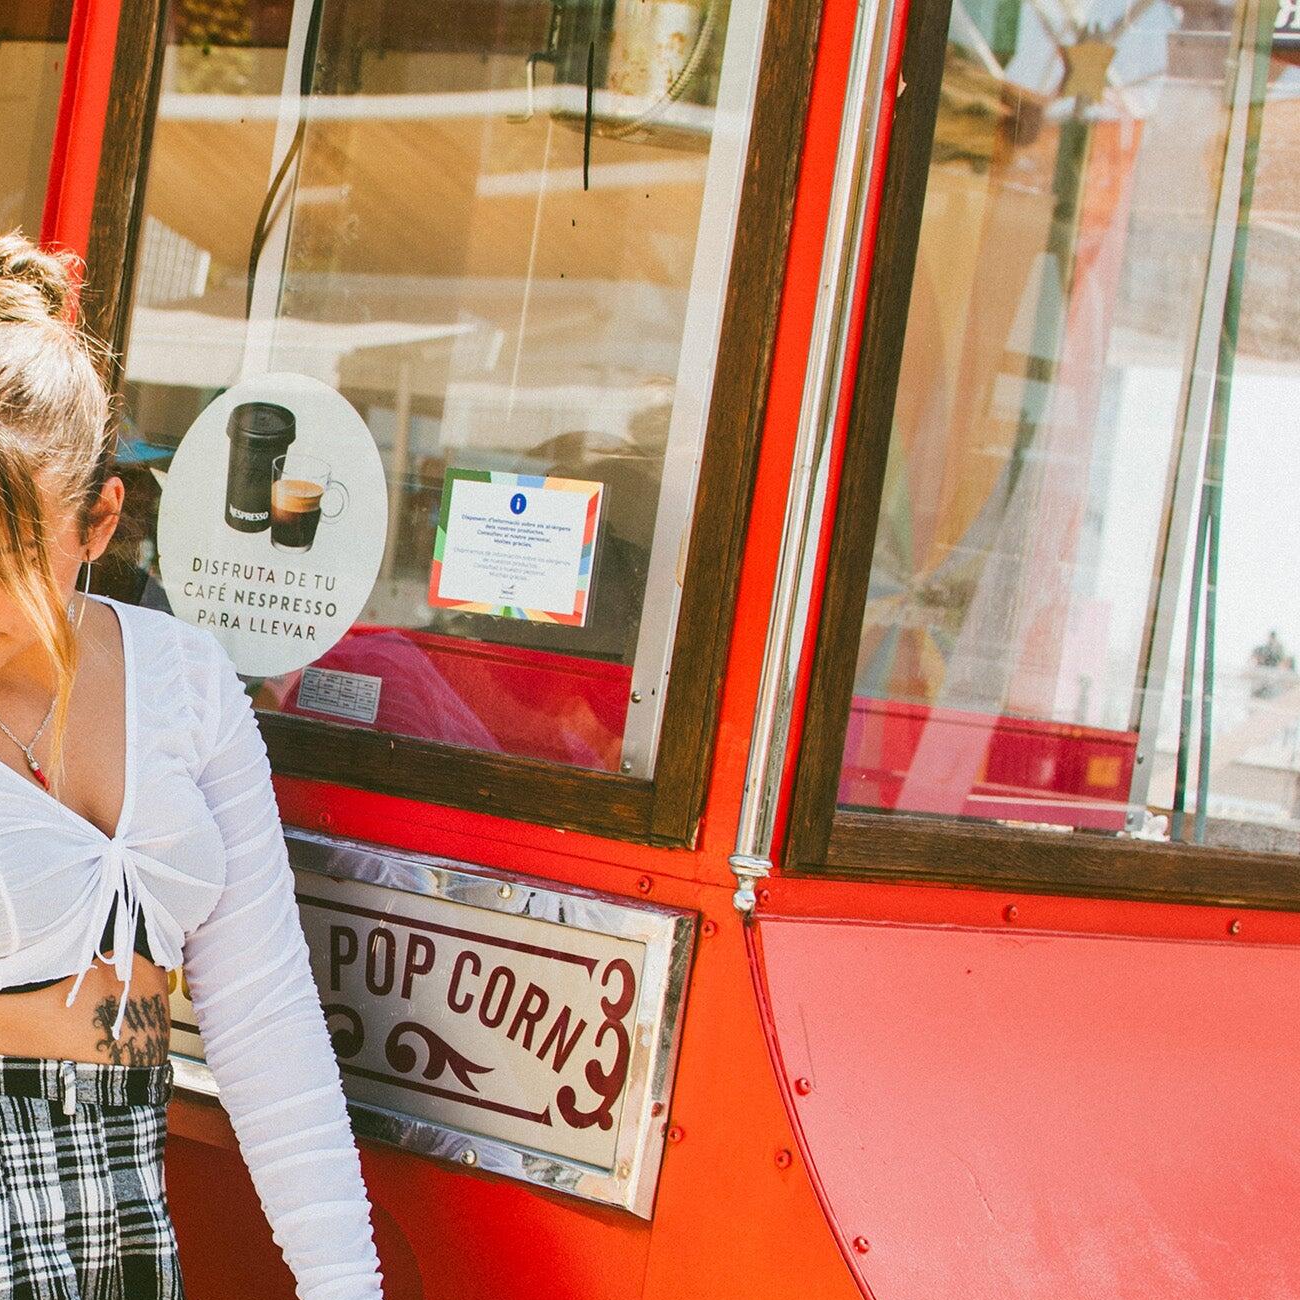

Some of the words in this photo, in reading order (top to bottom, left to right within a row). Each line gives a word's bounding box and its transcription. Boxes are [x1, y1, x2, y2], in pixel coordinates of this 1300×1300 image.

[229, 503, 269, 521] NESPRESSO
[192, 557, 275, 583] DISFRUTA
[285, 570, 306, 587] DE
[314, 574, 336, 591] TU
[183, 582, 226, 602] CAFÉ
[234, 590, 337, 618] NESPRESSO
[197, 609, 241, 630] PARA
[250, 617, 316, 641] LLEVAR
[330, 924, 436, 1000] POP
[447, 950, 589, 1074] CORN
